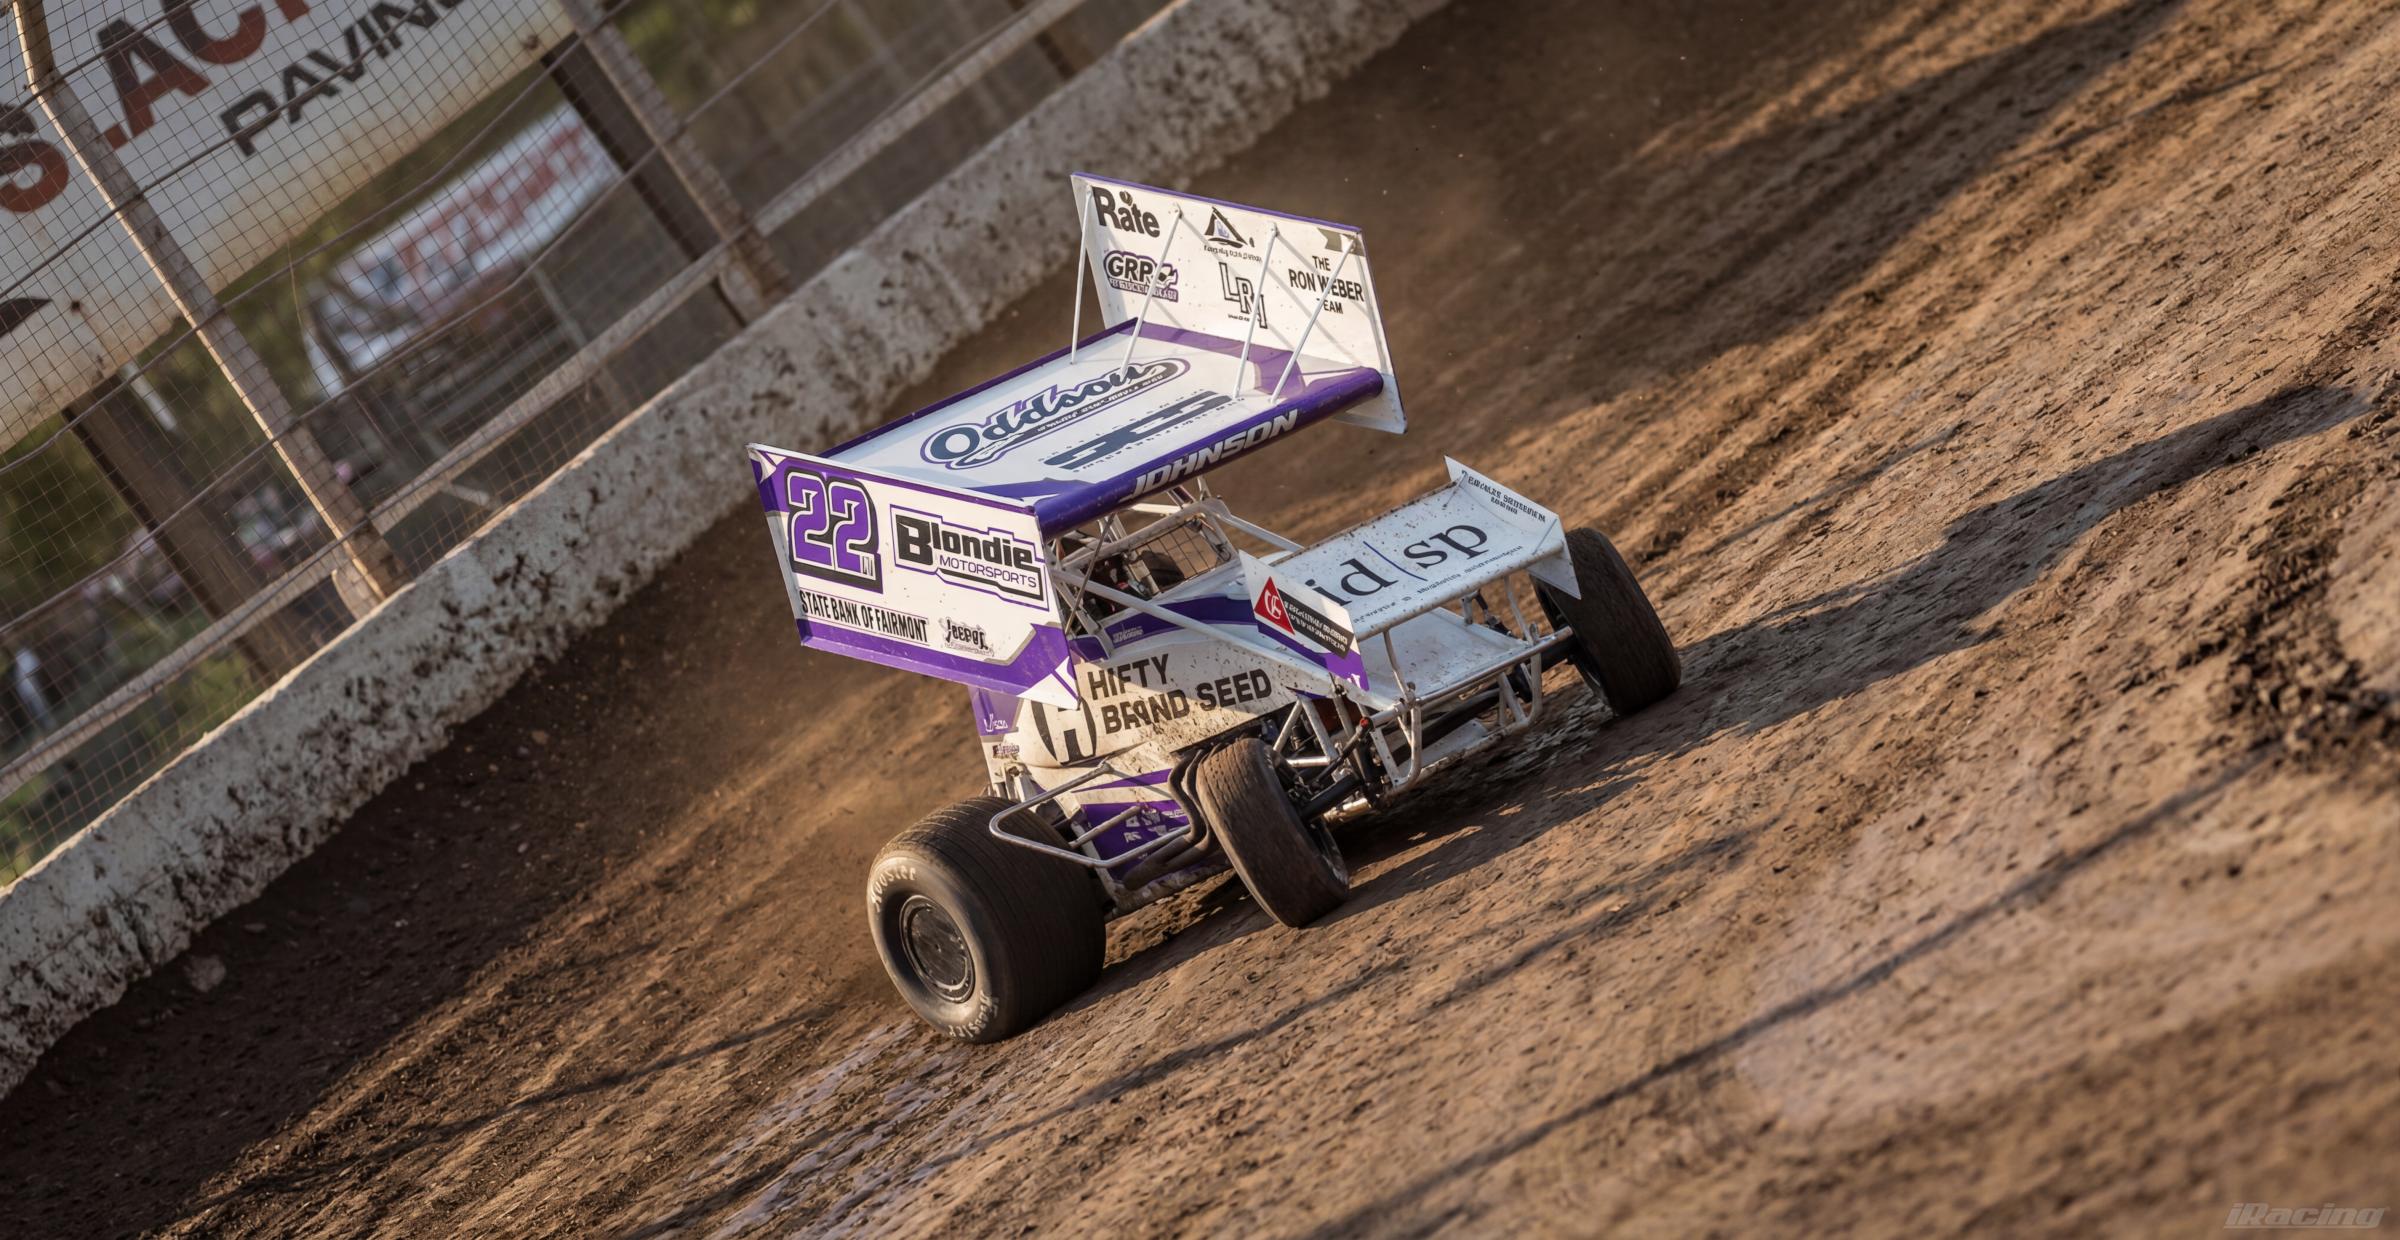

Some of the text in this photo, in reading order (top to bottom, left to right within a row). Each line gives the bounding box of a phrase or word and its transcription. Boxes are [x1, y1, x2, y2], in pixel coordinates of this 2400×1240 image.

[219, 0, 464, 157] PAVIN
[1107, 256, 1154, 283] GRP
[1312, 255, 1331, 271] THE
[1288, 268, 1365, 302] RON WEBER
[1316, 298, 1344, 314] EAM
[1128, 408, 1298, 501] JOHNSON
[895, 514, 1033, 568] Blondie
[939, 555, 1037, 588] MOTORSPORTS
[800, 589, 831, 618] STATE
[830, 598, 861, 626] BANK
[860, 605, 874, 629] OF
[874, 610, 928, 642] FAIRMONT
[1197, 668, 1272, 712] SEED
